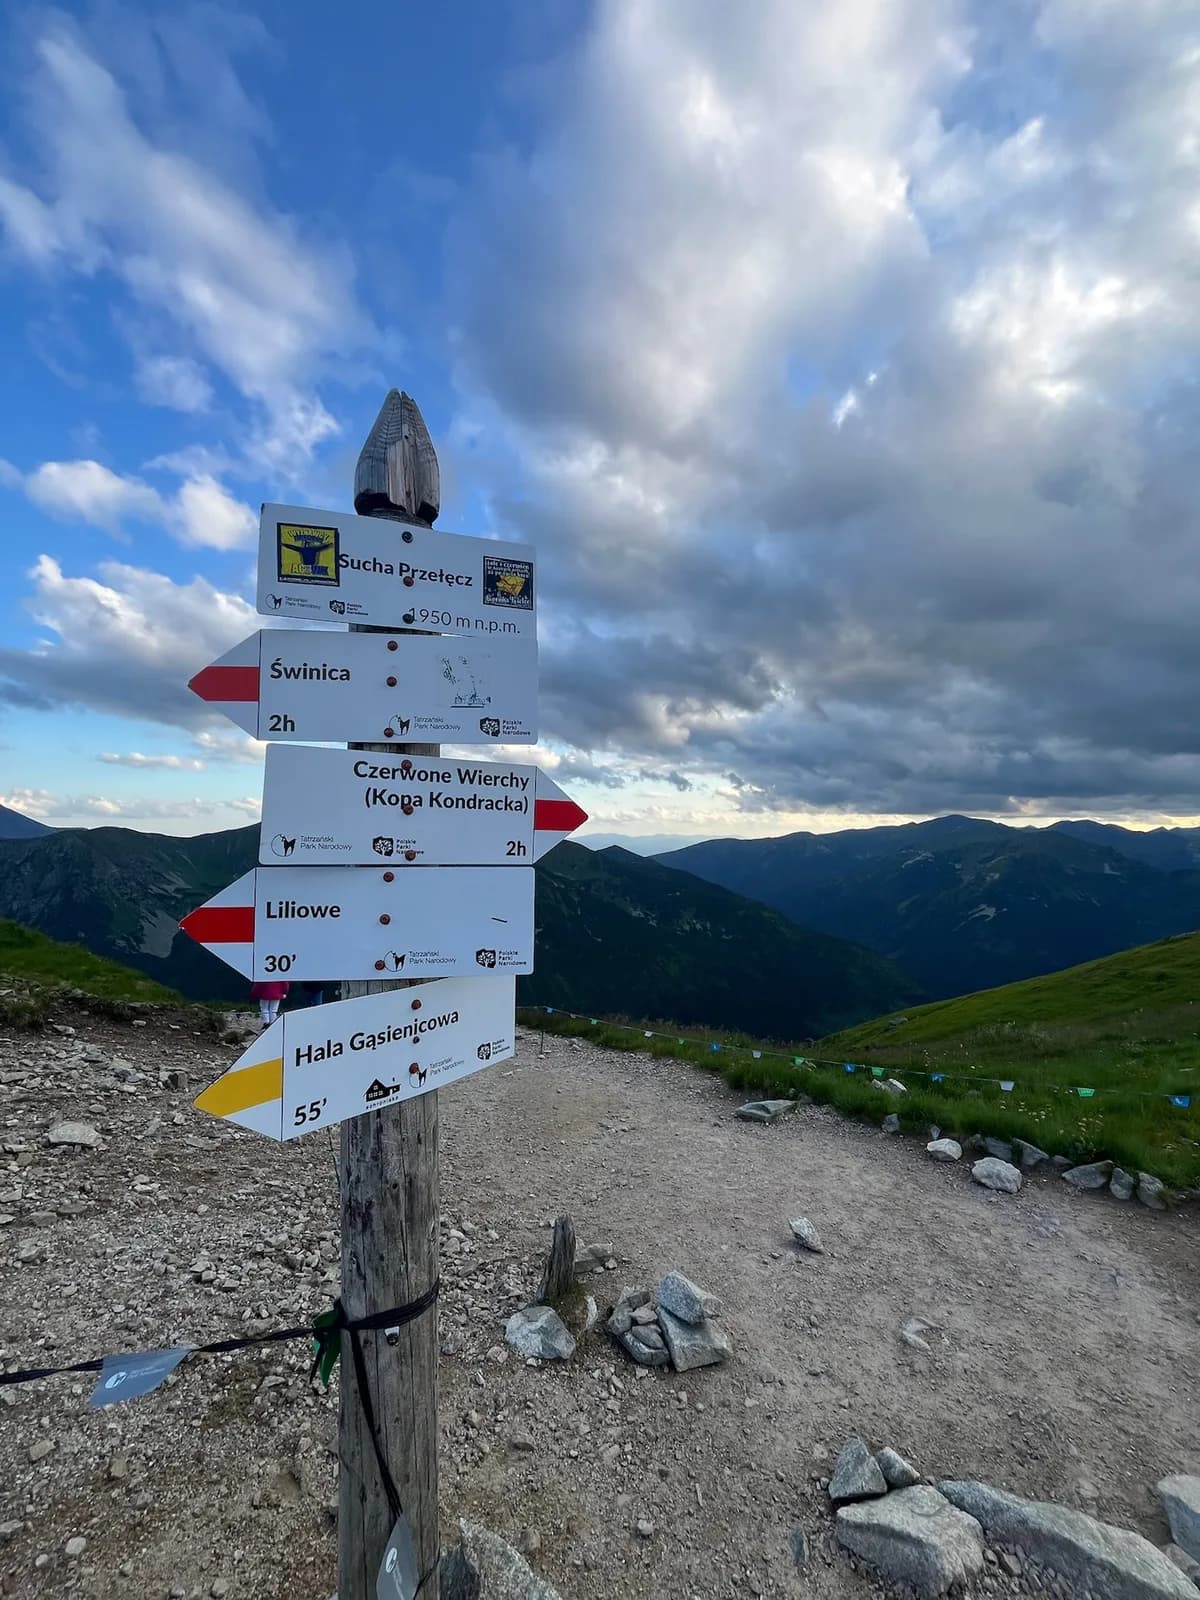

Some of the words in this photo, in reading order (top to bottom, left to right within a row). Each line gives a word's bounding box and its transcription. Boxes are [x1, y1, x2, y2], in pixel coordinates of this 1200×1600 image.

[338, 553, 394, 576] Sucha
[399, 562, 473, 588] Przełęcz
[409, 607, 452, 626] 1950
[456, 615, 470, 628] m
[474, 617, 521, 634] n.p.m.
[269, 657, 351, 682] Świnica
[268, 714, 295, 733] 2h
[353, 760, 452, 784] Czerwone
[457, 768, 530, 792] Wierchy
[365, 786, 423, 810] (Kopa
[429, 791, 529, 815] Kondracka)
[505, 840, 527, 857] 2h
[265, 901, 341, 919] Liliowe
[295, 1039, 344, 1067] Hala
[349, 1009, 460, 1051] Gąsienicowa
